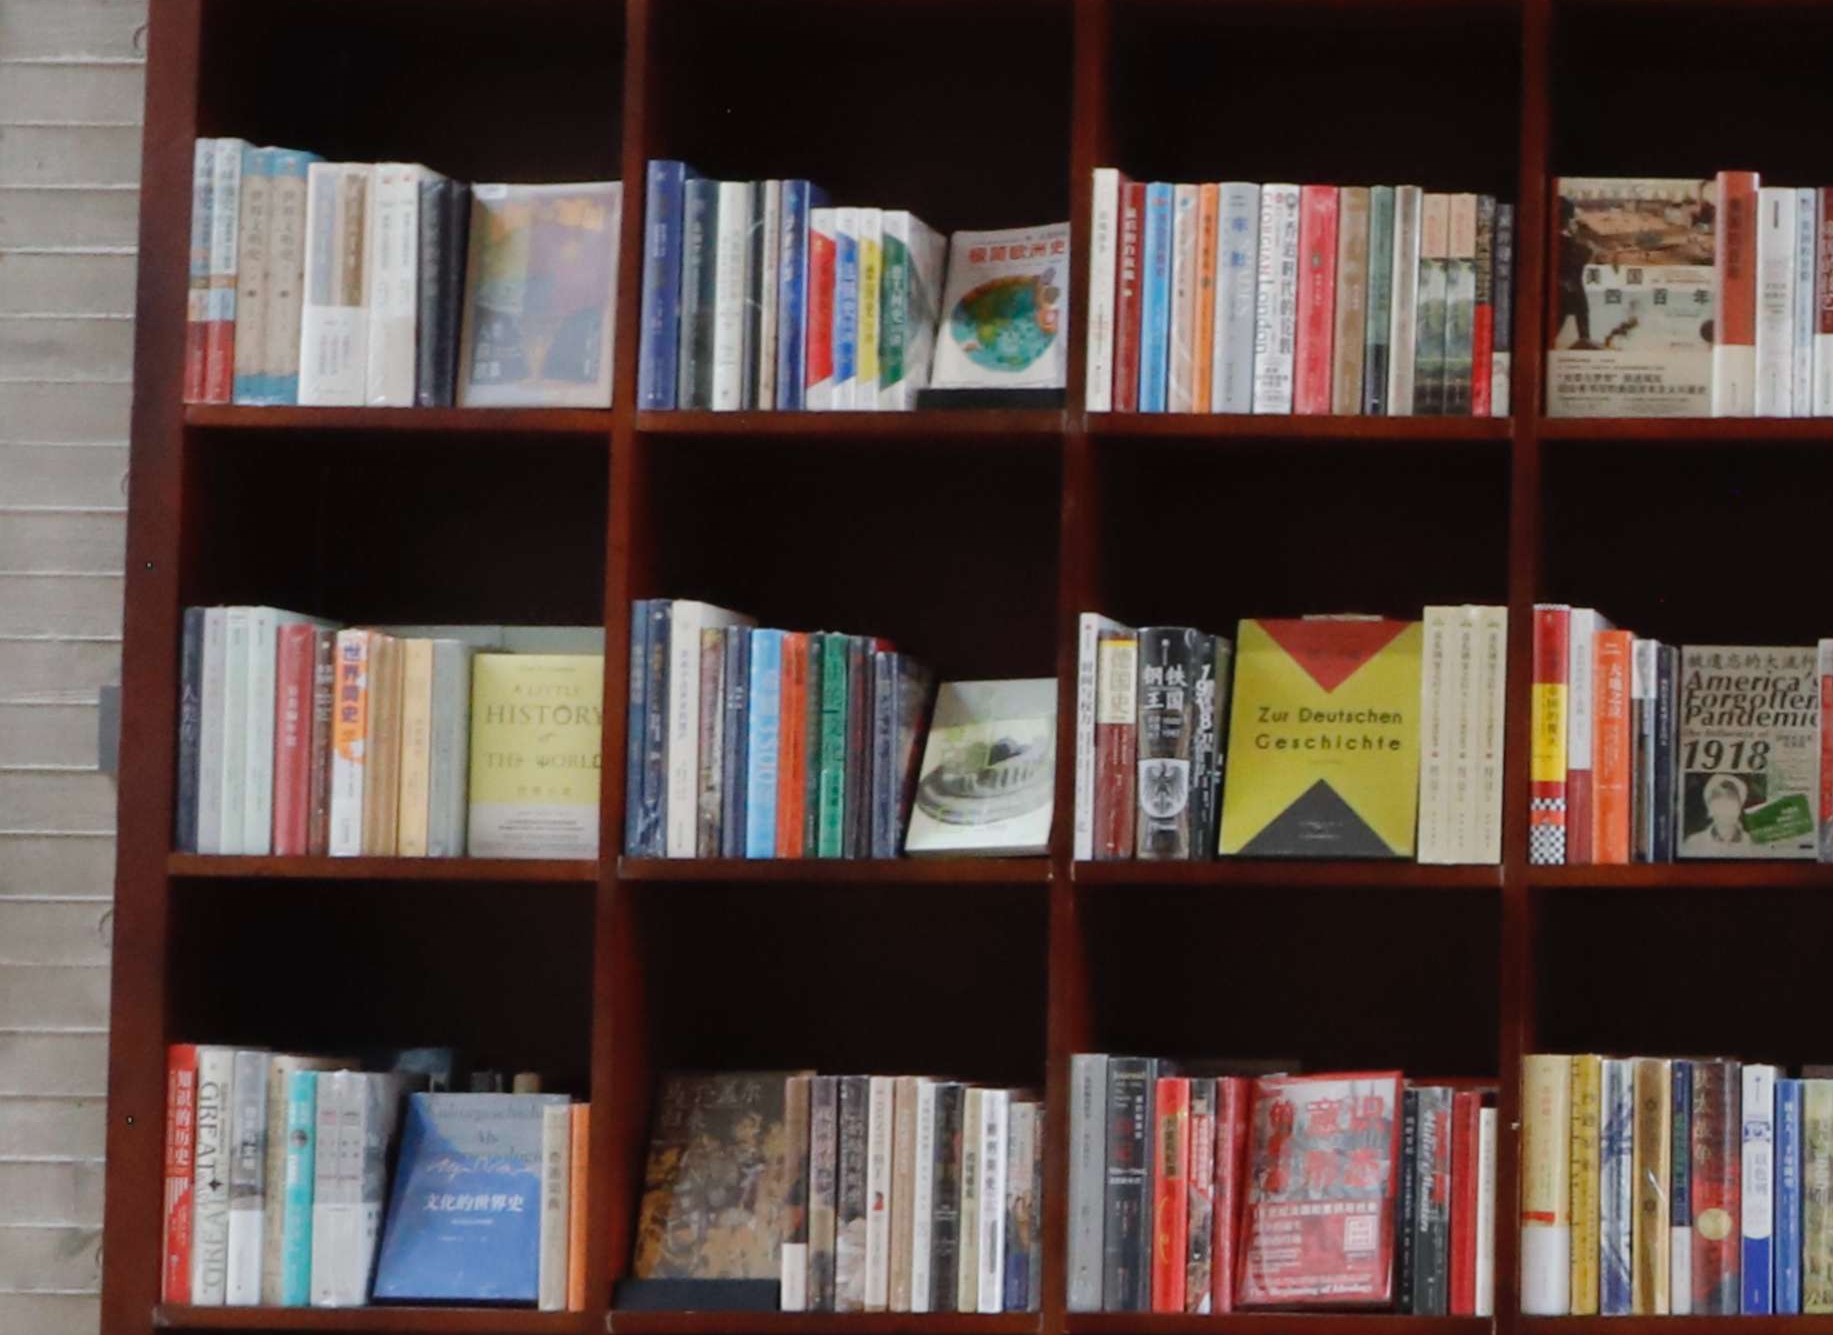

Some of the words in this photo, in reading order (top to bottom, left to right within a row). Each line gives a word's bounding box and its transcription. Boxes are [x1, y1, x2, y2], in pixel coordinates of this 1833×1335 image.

[967, 240, 1067, 266] 极简欧洲史
[1585, 265, 1644, 285] 美国
[1603, 286, 1712, 304] 四百年
[1143, 665, 1186, 687] 钢铁
[1144, 688, 1185, 711] 王国
[487, 706, 606, 728] HISTORY
[1257, 707, 1292, 724] Zur
[1298, 707, 1404, 725] Deutschen
[1254, 733, 1401, 753] Geschichte
[1684, 739, 1770, 772] 1918
[198, 1080, 220, 1174] GREAT
[422, 1193, 525, 1214] 文化的世界史
